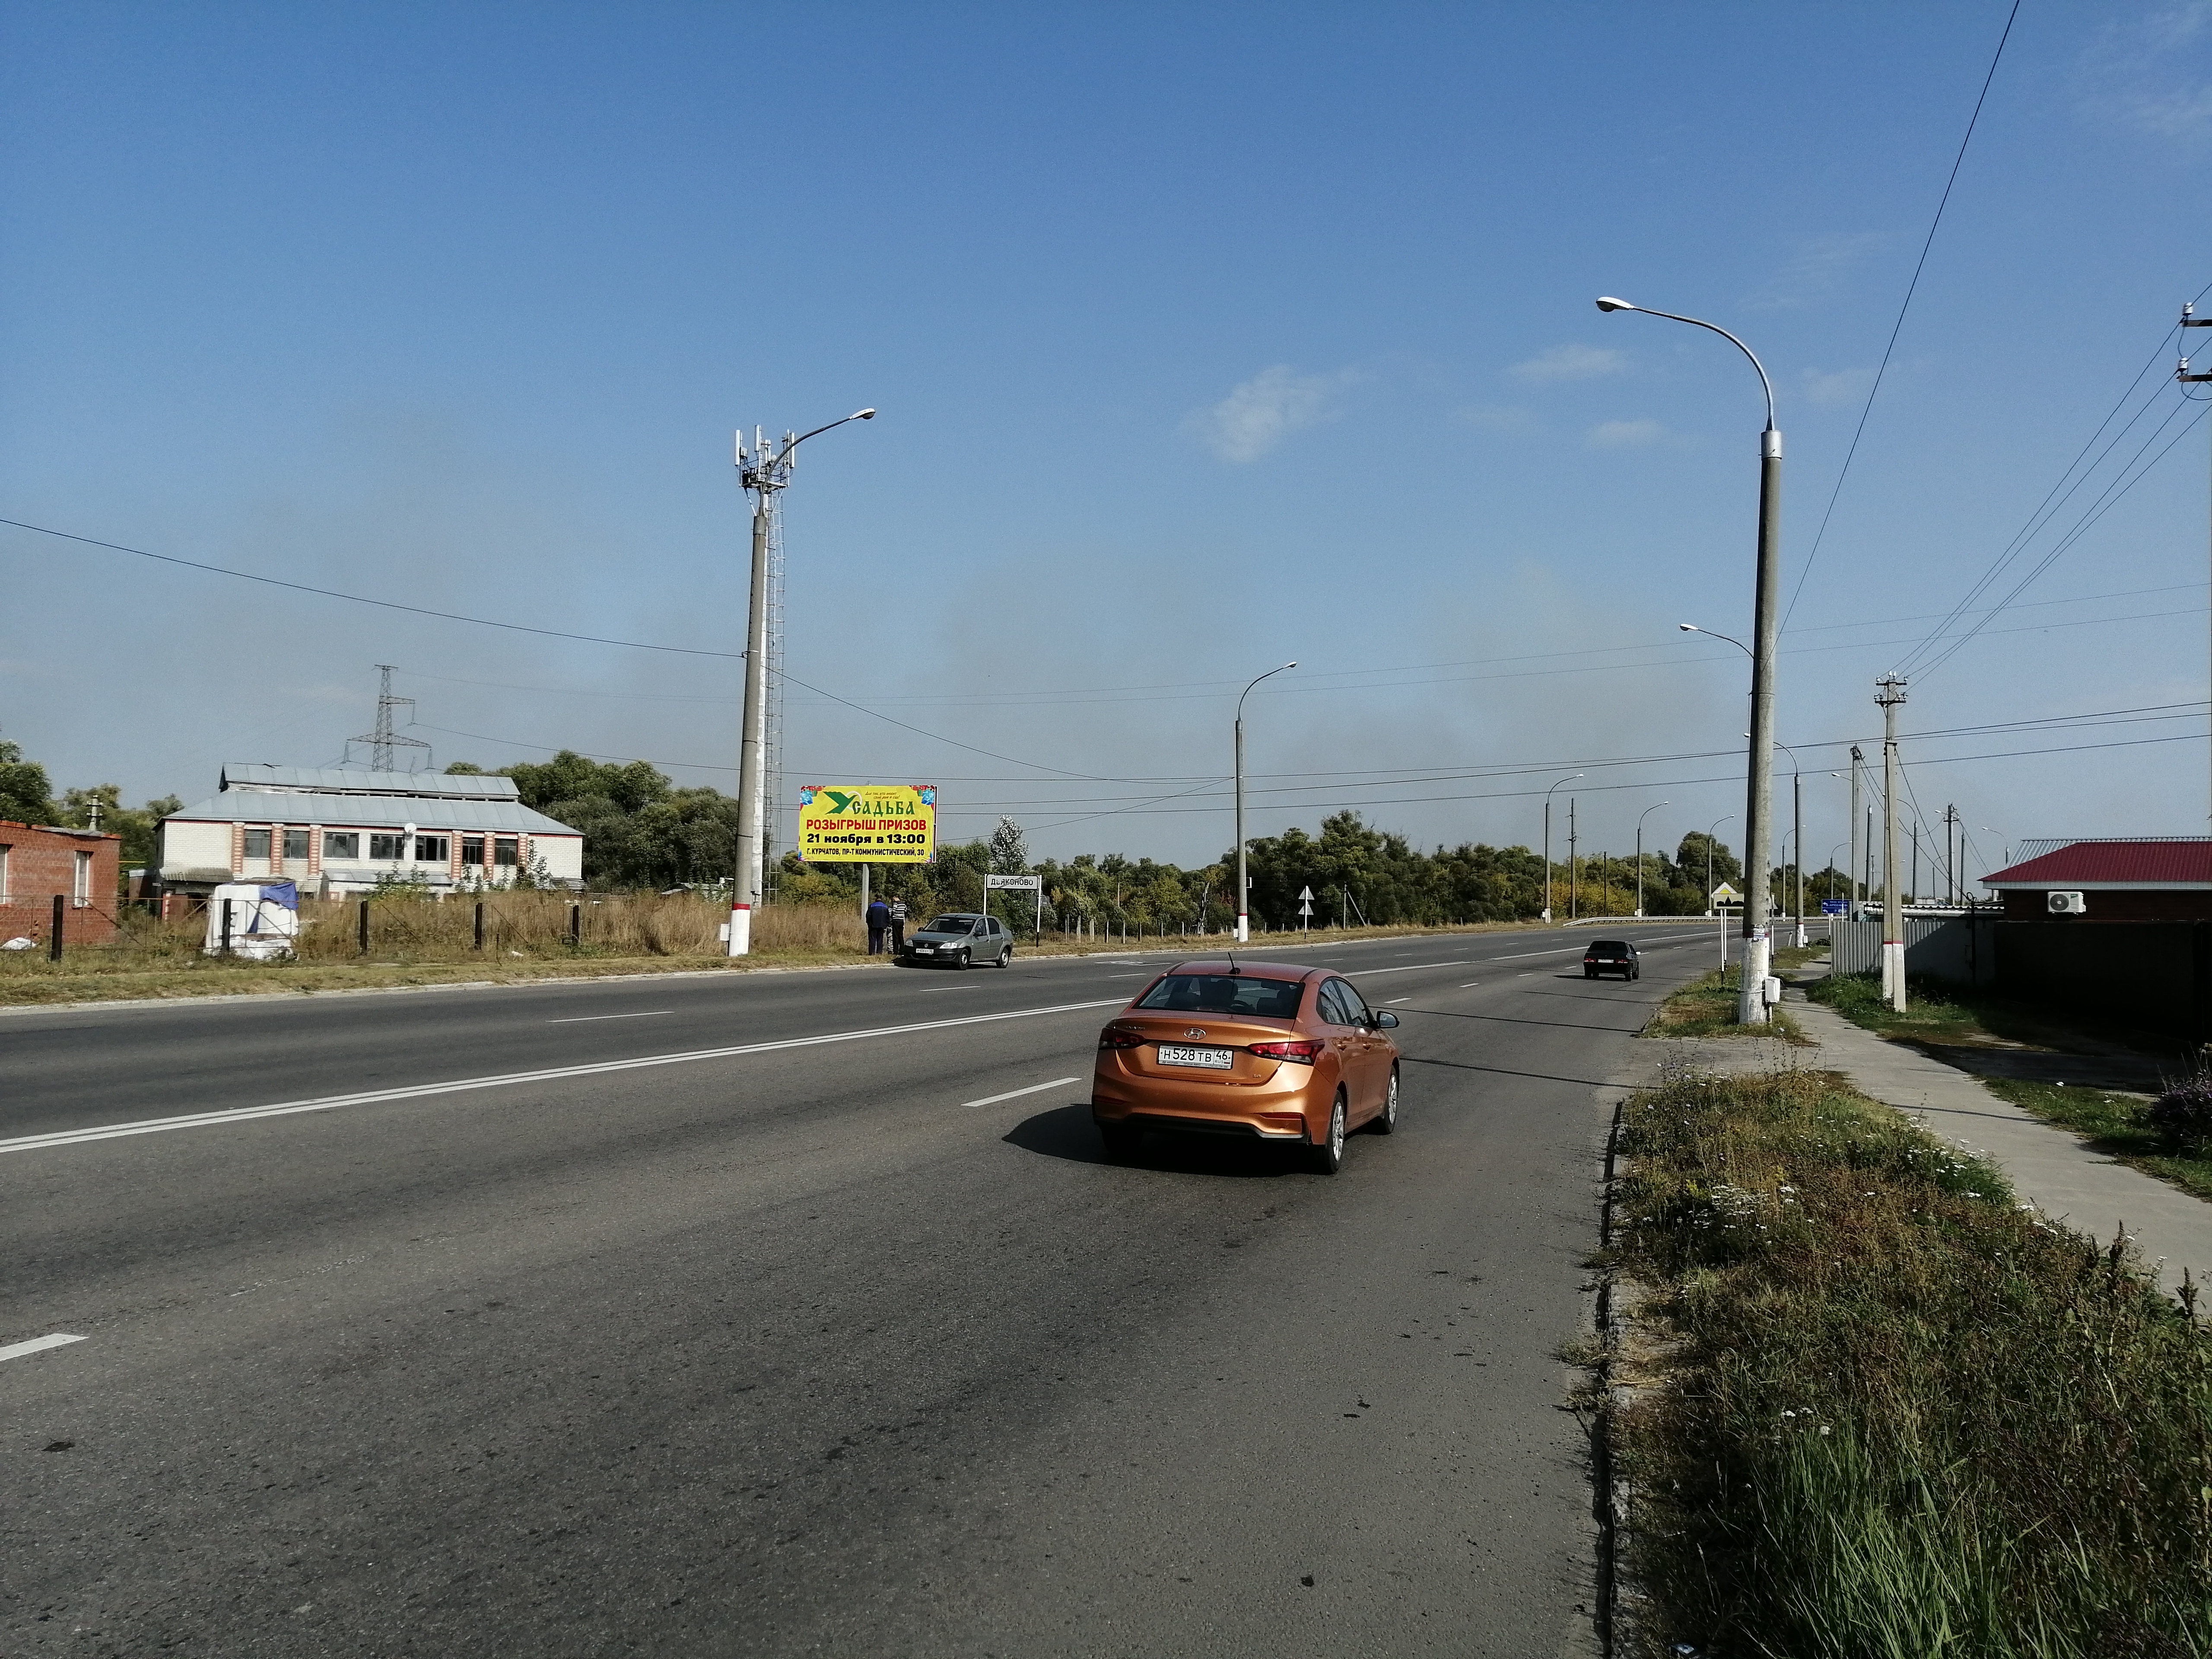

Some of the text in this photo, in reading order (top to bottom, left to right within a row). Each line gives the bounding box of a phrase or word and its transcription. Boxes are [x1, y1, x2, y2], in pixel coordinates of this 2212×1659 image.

[807, 820, 926, 830] РОЗЫГРЫШ ПРИЗОВ
[807, 833, 820, 843] 21
[824, 834, 871, 845] ноября
[887, 834, 925, 844] 13:00
[855, 847, 916, 856] КОММУНИСТИЧЕСКИЙ,
[1216, 1051, 1228, 1060] 46
